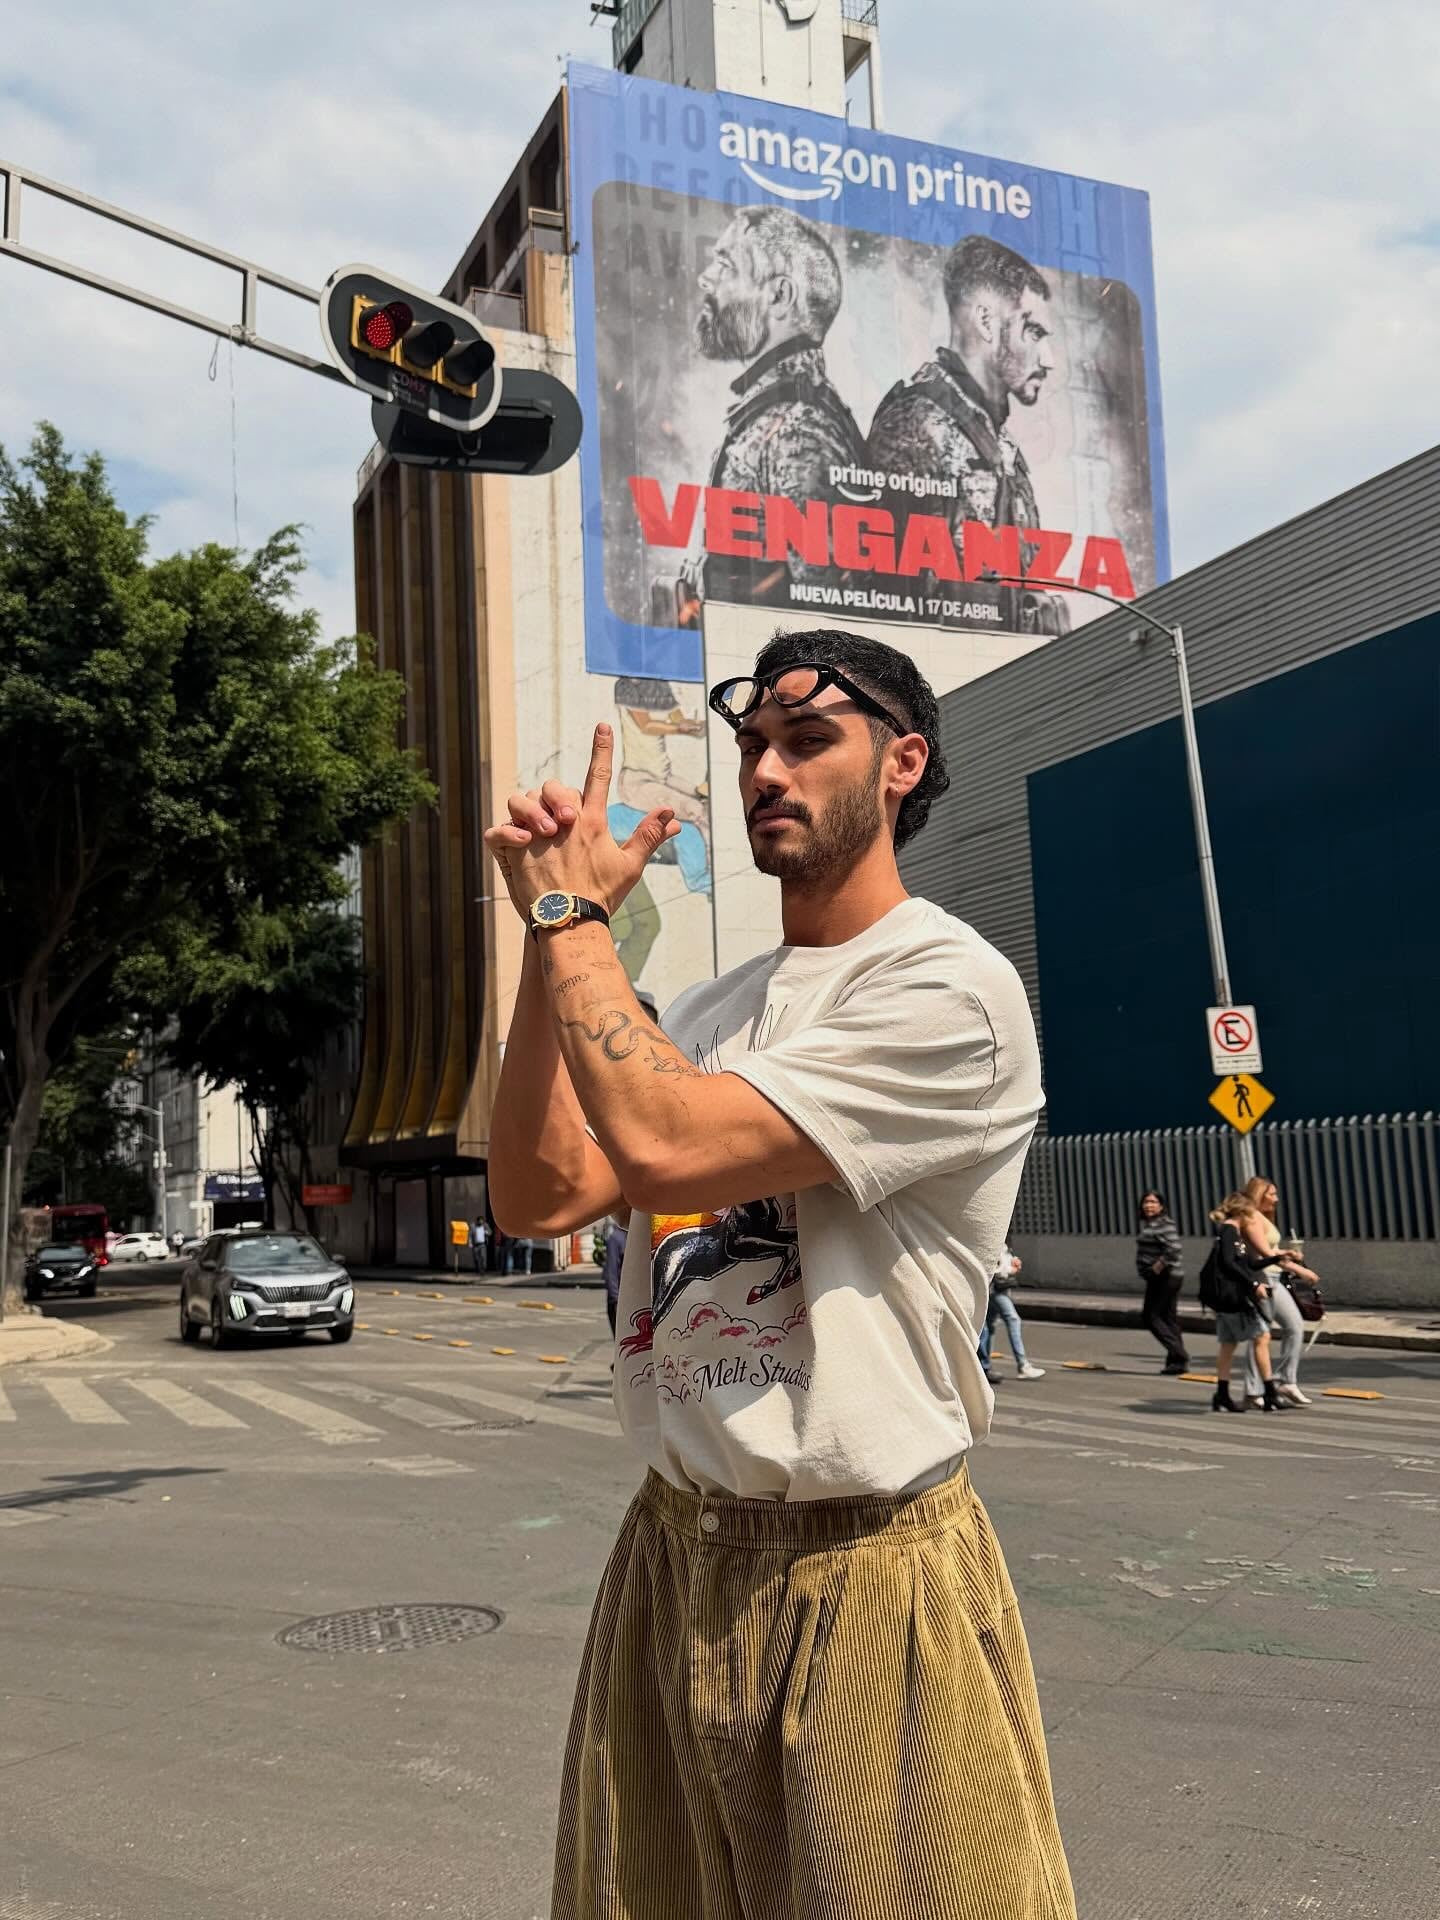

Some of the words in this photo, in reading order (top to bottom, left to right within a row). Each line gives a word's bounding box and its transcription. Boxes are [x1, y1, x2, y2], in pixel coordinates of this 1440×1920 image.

[719, 121, 897, 192] amazon
[906, 161, 1032, 219] prime
[829, 463, 883, 489] prime
[886, 472, 958, 499] original
[628, 475, 1137, 600] VENGANZA
[790, 584, 843, 606] NUEVA
[844, 589, 915, 613] PELÍCULA
[926, 599, 939, 616] 17
[943, 600, 961, 617] DE
[962, 602, 1004, 621] ABRIL
[692, 1356, 748, 1402] Melt
[750, 1353, 812, 1392] Studios
